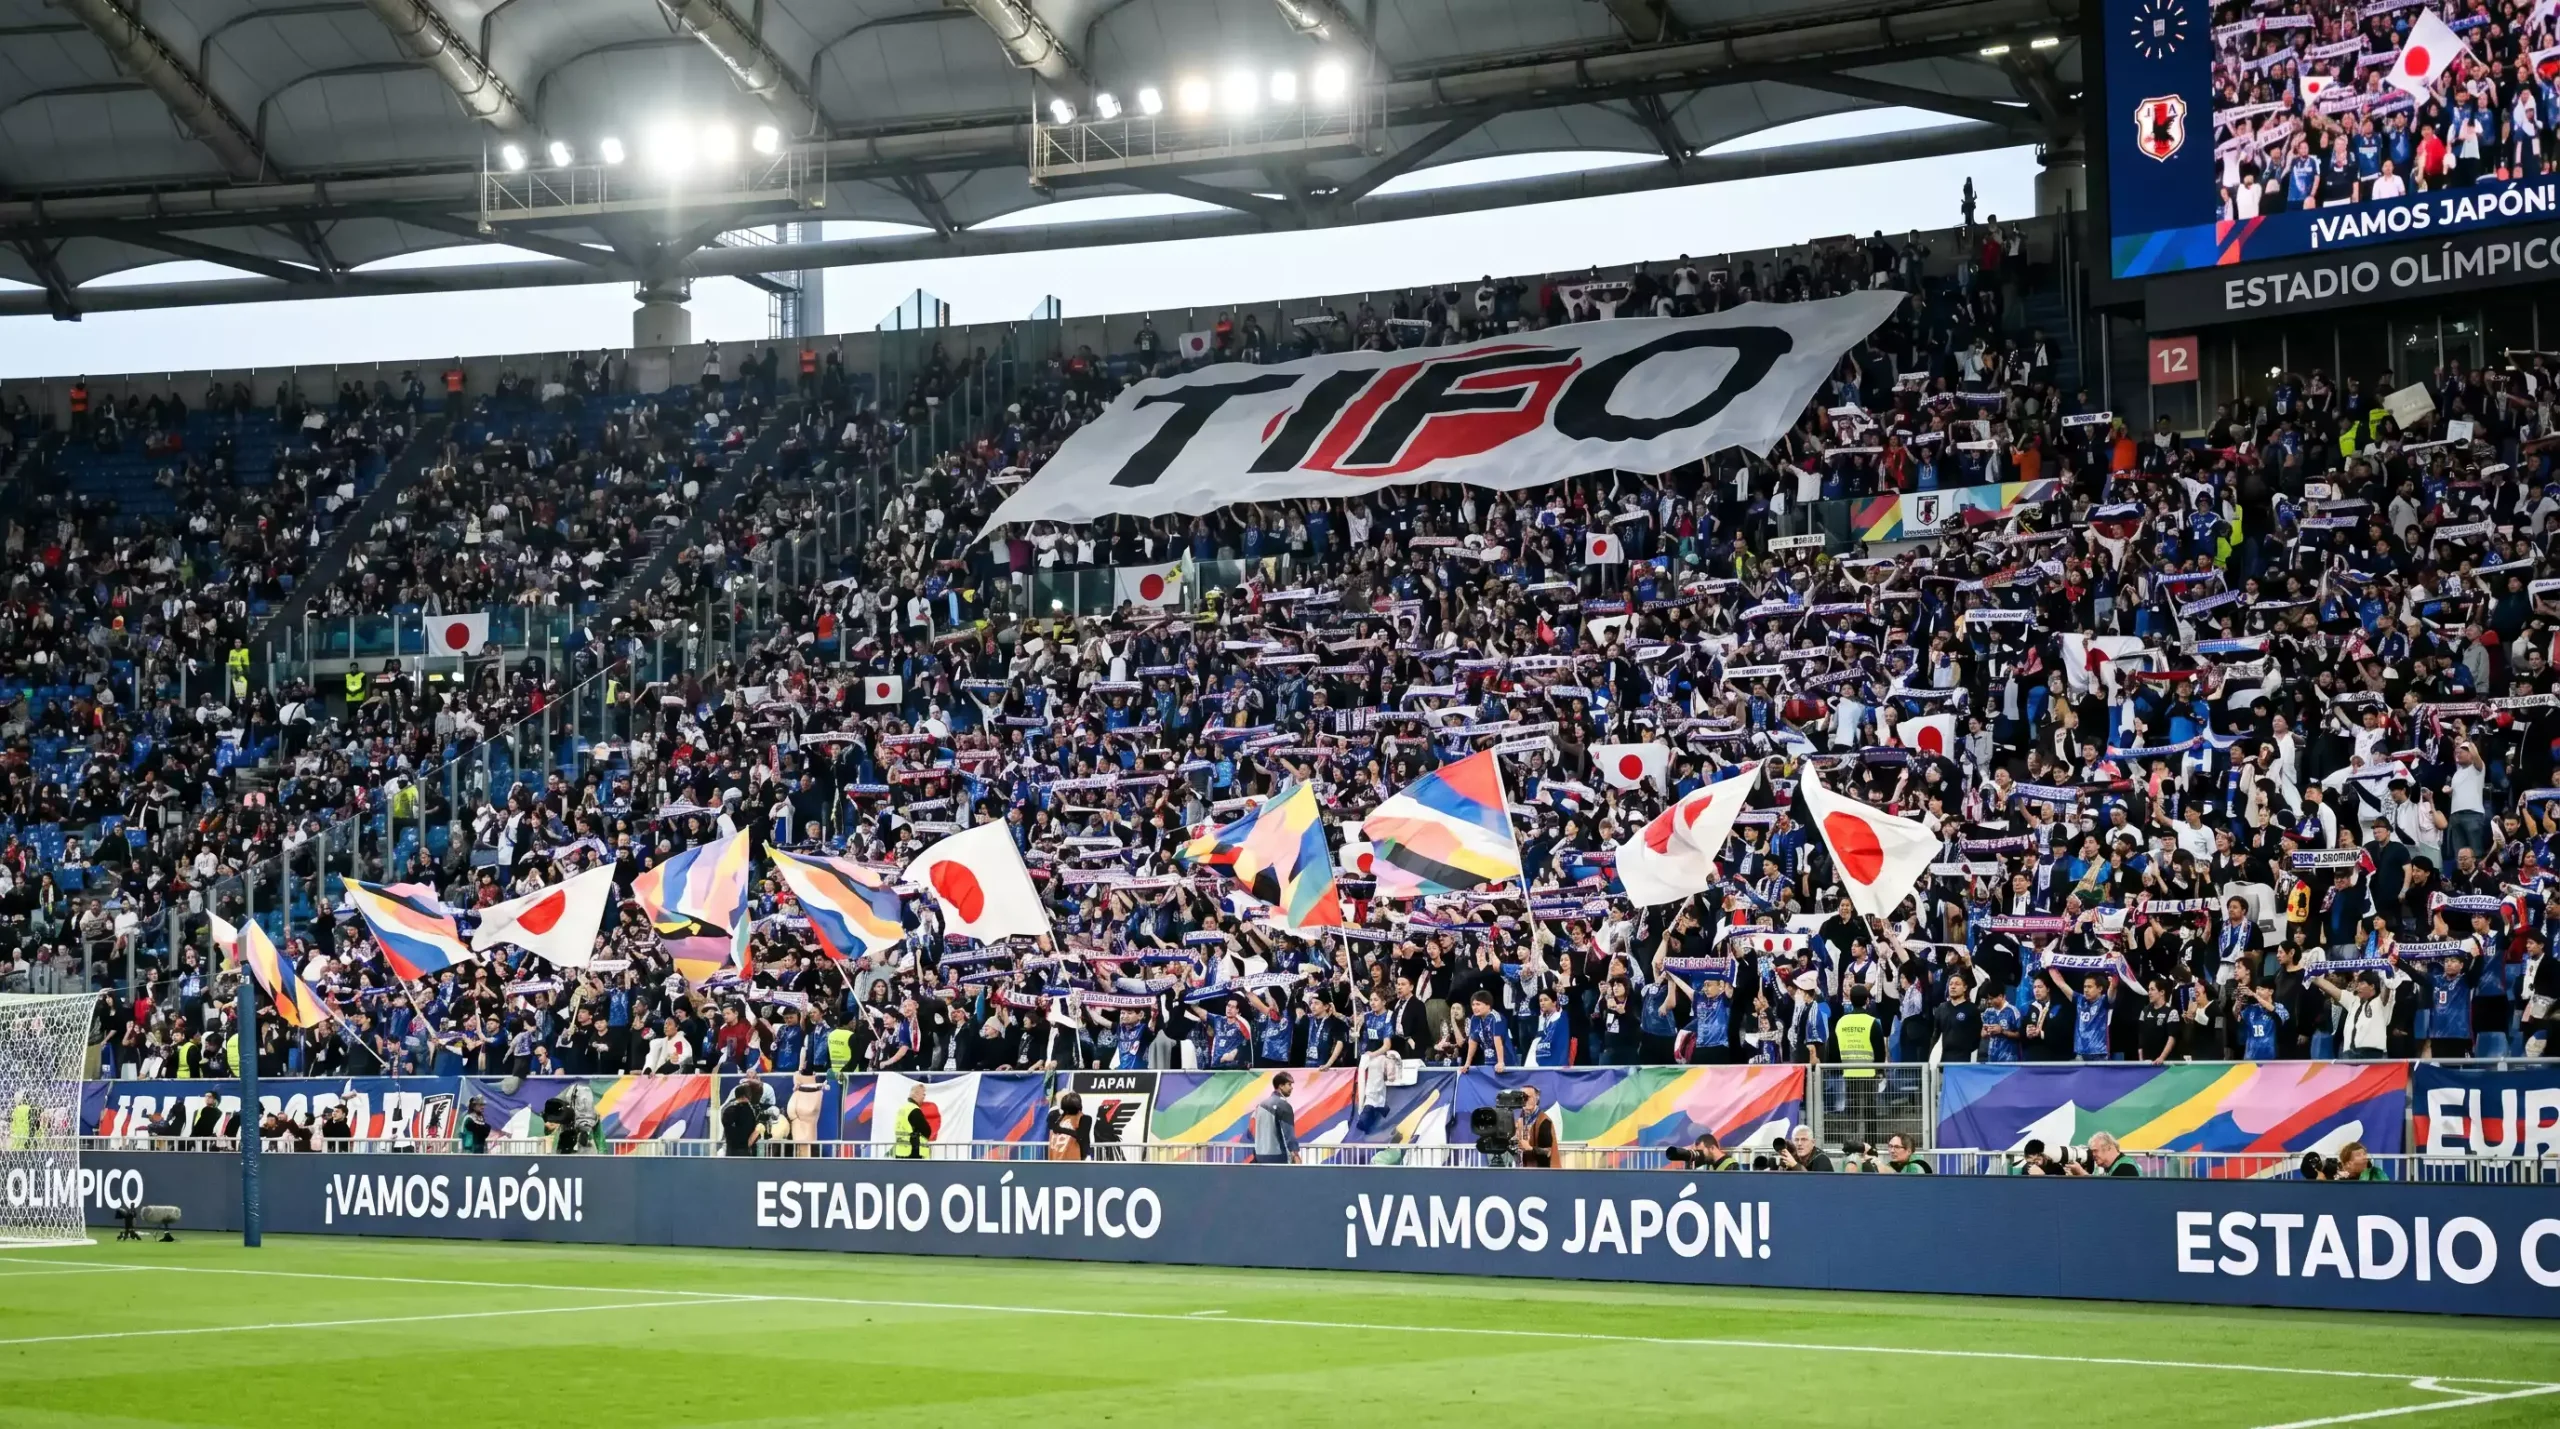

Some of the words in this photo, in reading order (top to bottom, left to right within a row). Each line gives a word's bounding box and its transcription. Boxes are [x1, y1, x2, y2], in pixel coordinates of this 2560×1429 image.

[2310, 203, 2431, 249] ¡VAMOS
[2438, 183, 2556, 226] JAPÓN!
[2225, 260, 2380, 310] ESTADIO
[2157, 347, 2189, 374] 12
[1110, 326, 1793, 488] TIFO
[1090, 1076, 1136, 1090] JAPAN
[7, 1157, 144, 1210] OLÍMPICO
[325, 1173, 450, 1225] ¡VAMOS
[456, 1162, 583, 1223] JAPÓN!
[756, 1180, 931, 1233] ESTADIO
[940, 1169, 1162, 1240] OLÍMPICO
[1345, 1193, 1549, 1258] ¡VAMOS
[1561, 1181, 1771, 1260] JAPÓN!
[2176, 1211, 2498, 1285] ESTADIO
